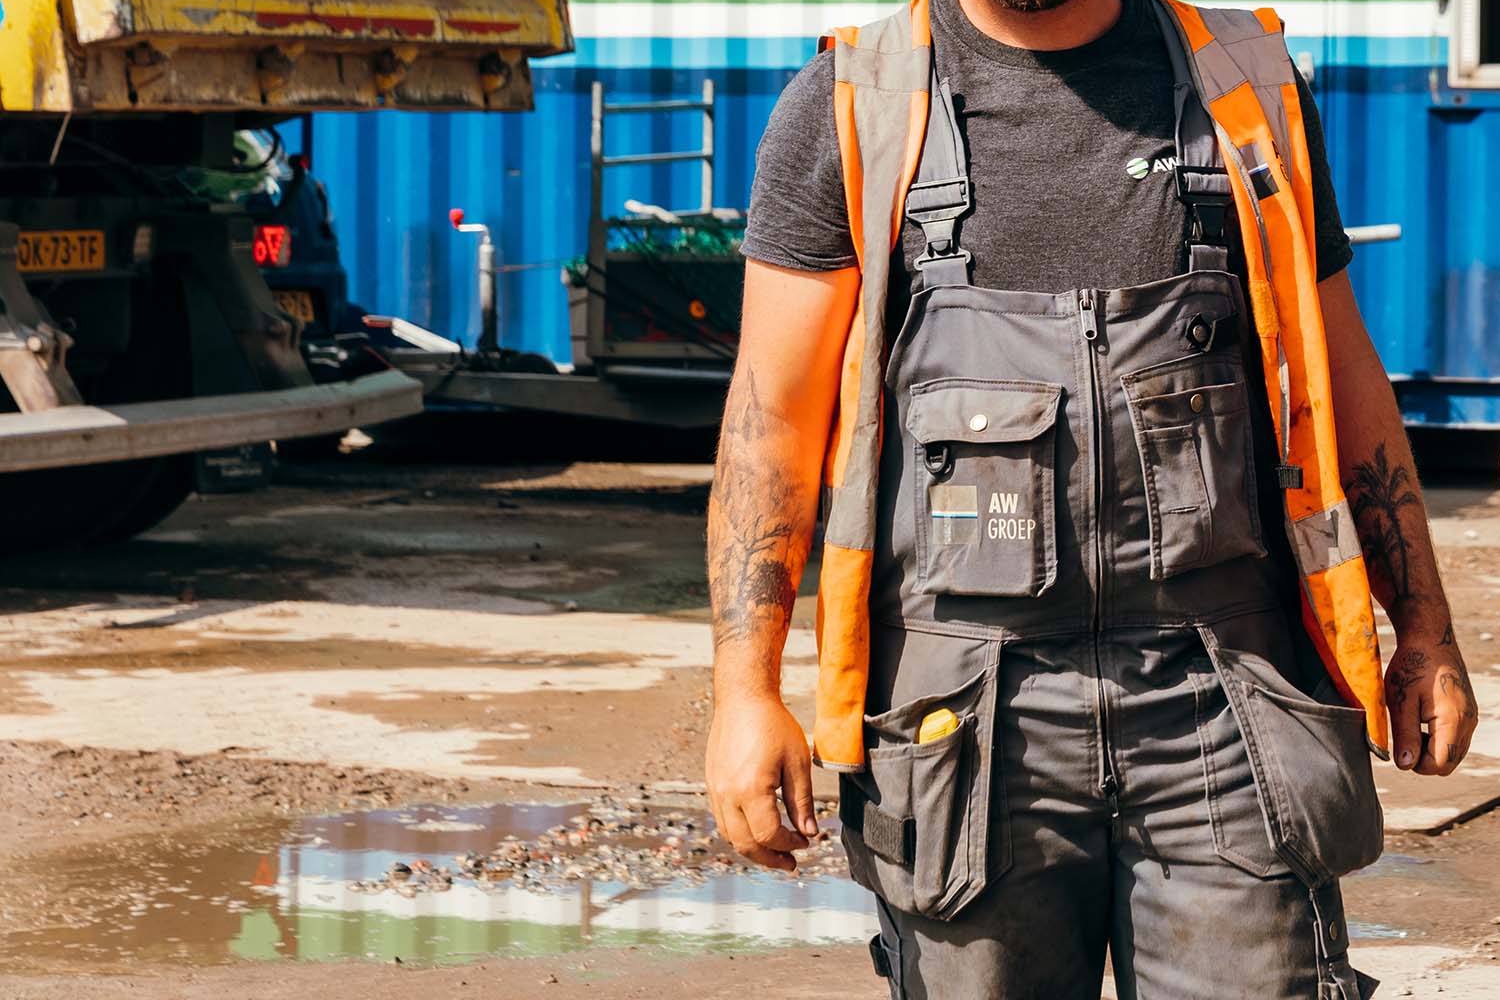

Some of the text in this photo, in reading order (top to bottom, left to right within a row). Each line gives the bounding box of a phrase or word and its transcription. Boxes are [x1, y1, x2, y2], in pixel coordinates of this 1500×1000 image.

[1152, 157, 1179, 173] AW
[988, 493, 1018, 514] AW
[987, 518, 1036, 540] GROEP
